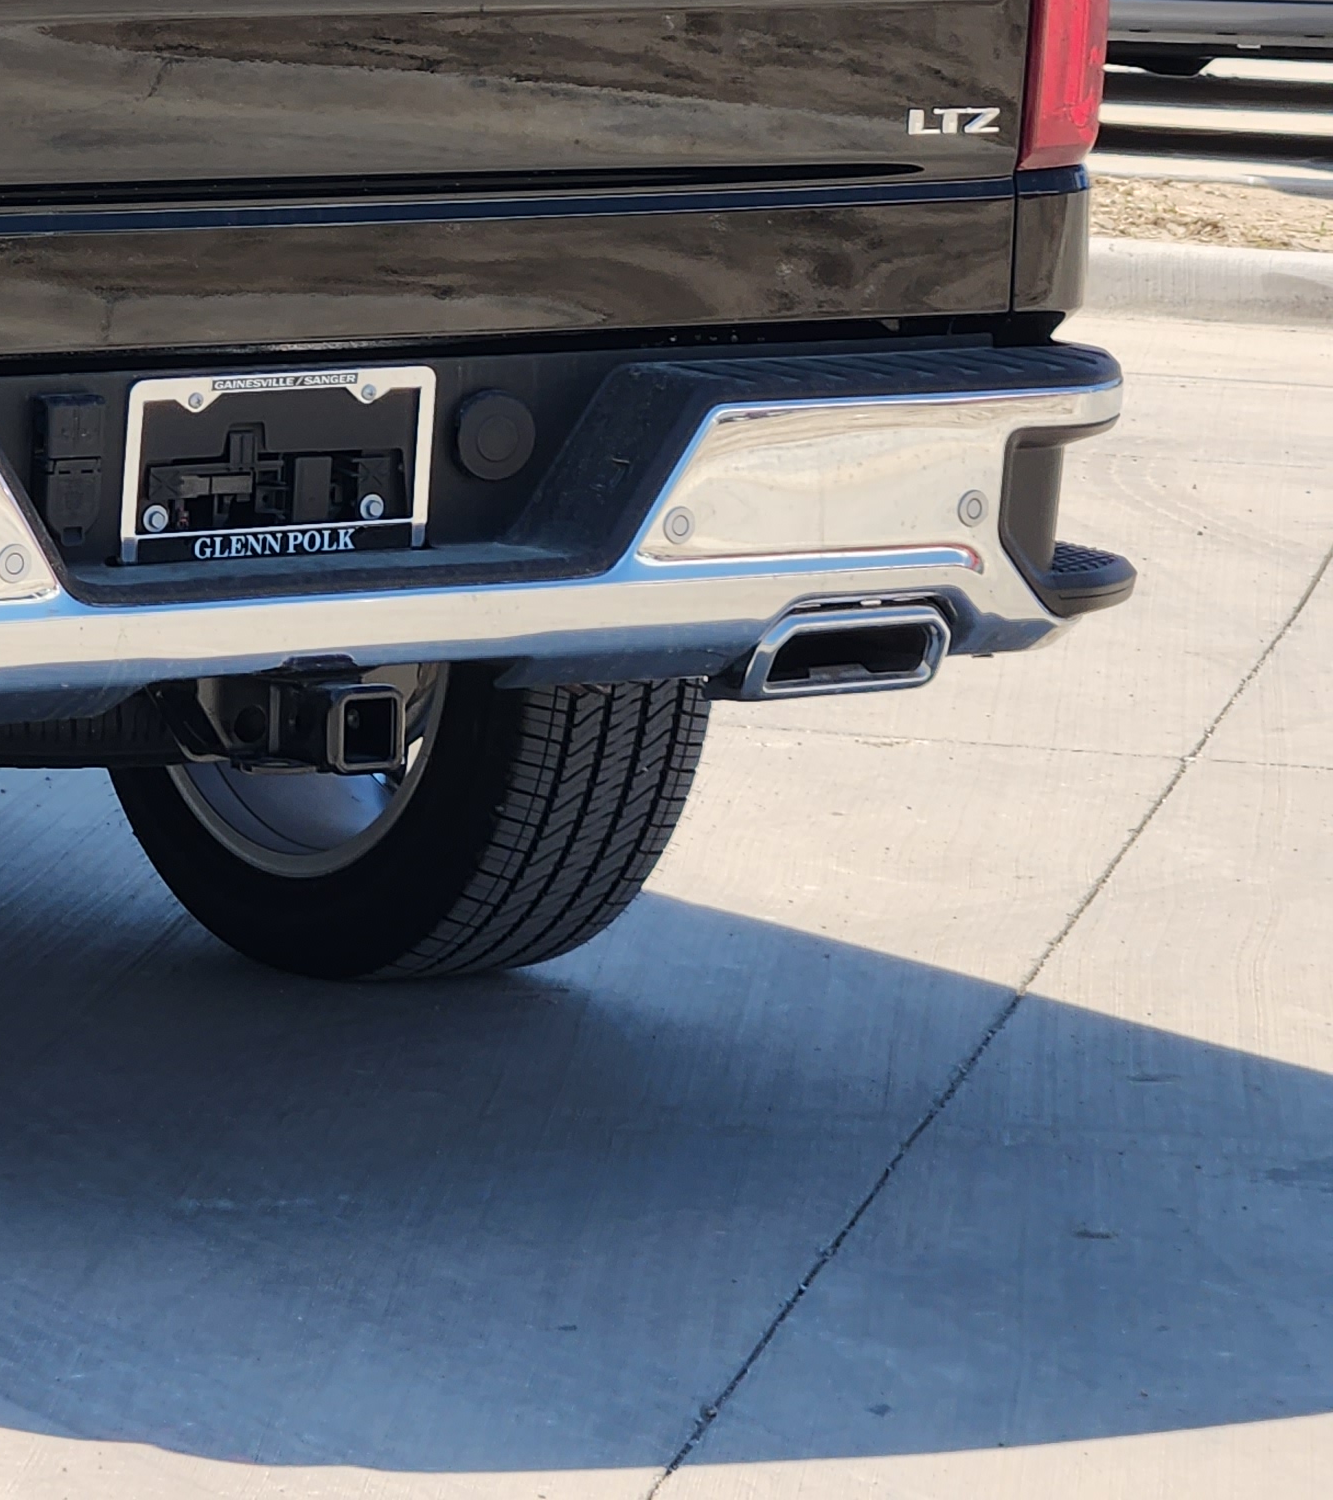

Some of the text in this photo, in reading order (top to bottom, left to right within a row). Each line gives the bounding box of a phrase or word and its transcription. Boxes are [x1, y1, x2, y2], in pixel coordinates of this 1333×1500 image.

[908, 107, 1001, 135] LTZ
[194, 528, 355, 559] GLENN POLK
